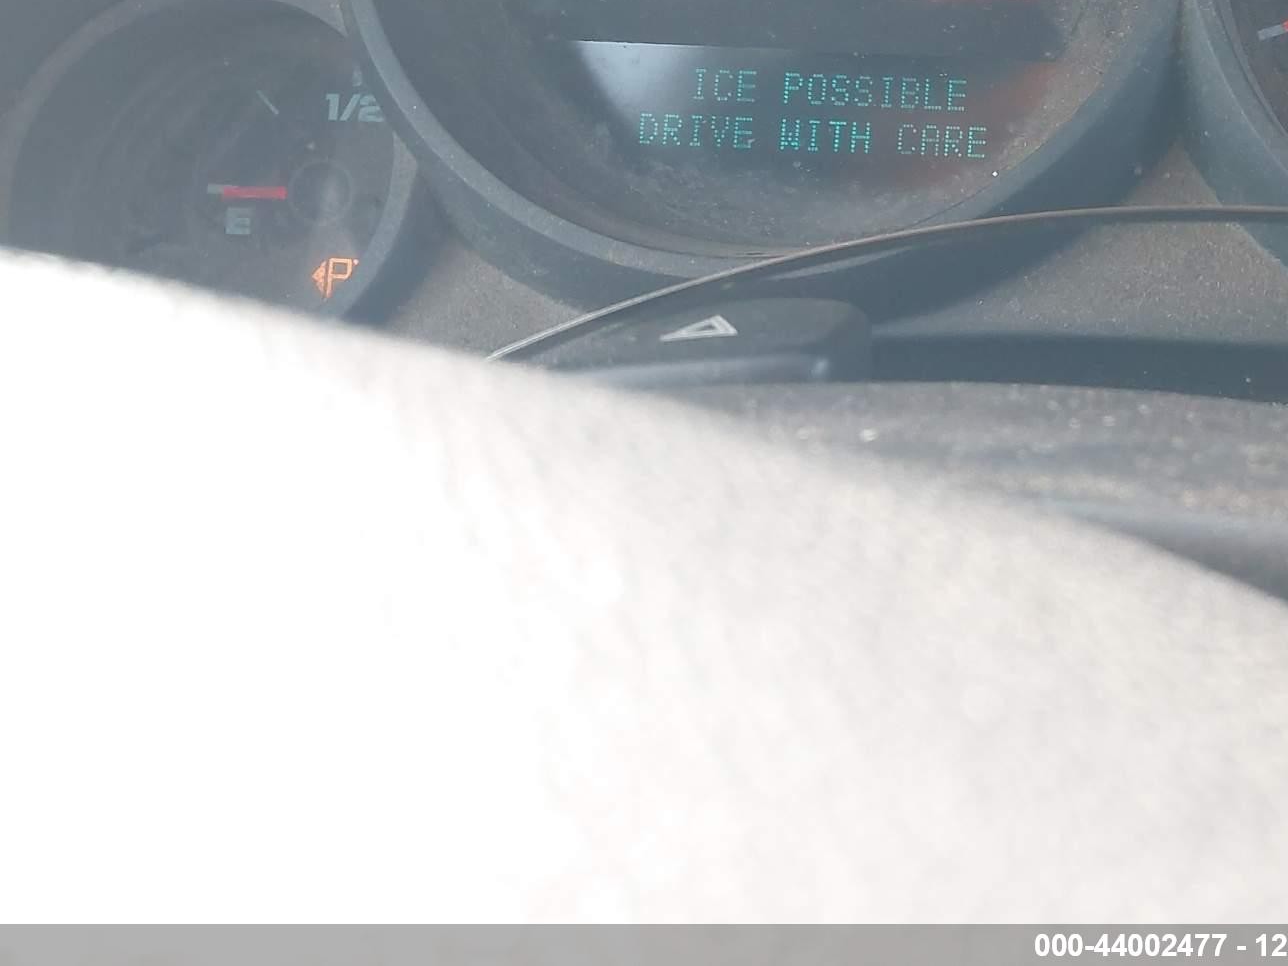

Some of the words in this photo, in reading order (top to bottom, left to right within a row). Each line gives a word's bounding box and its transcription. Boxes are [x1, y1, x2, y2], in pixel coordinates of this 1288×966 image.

[692, 68, 757, 103] ICE
[783, 70, 968, 112] POSSIBLE
[638, 112, 754, 150] DRIVE
[780, 118, 872, 155] WITH
[897, 124, 988, 159] CARE
